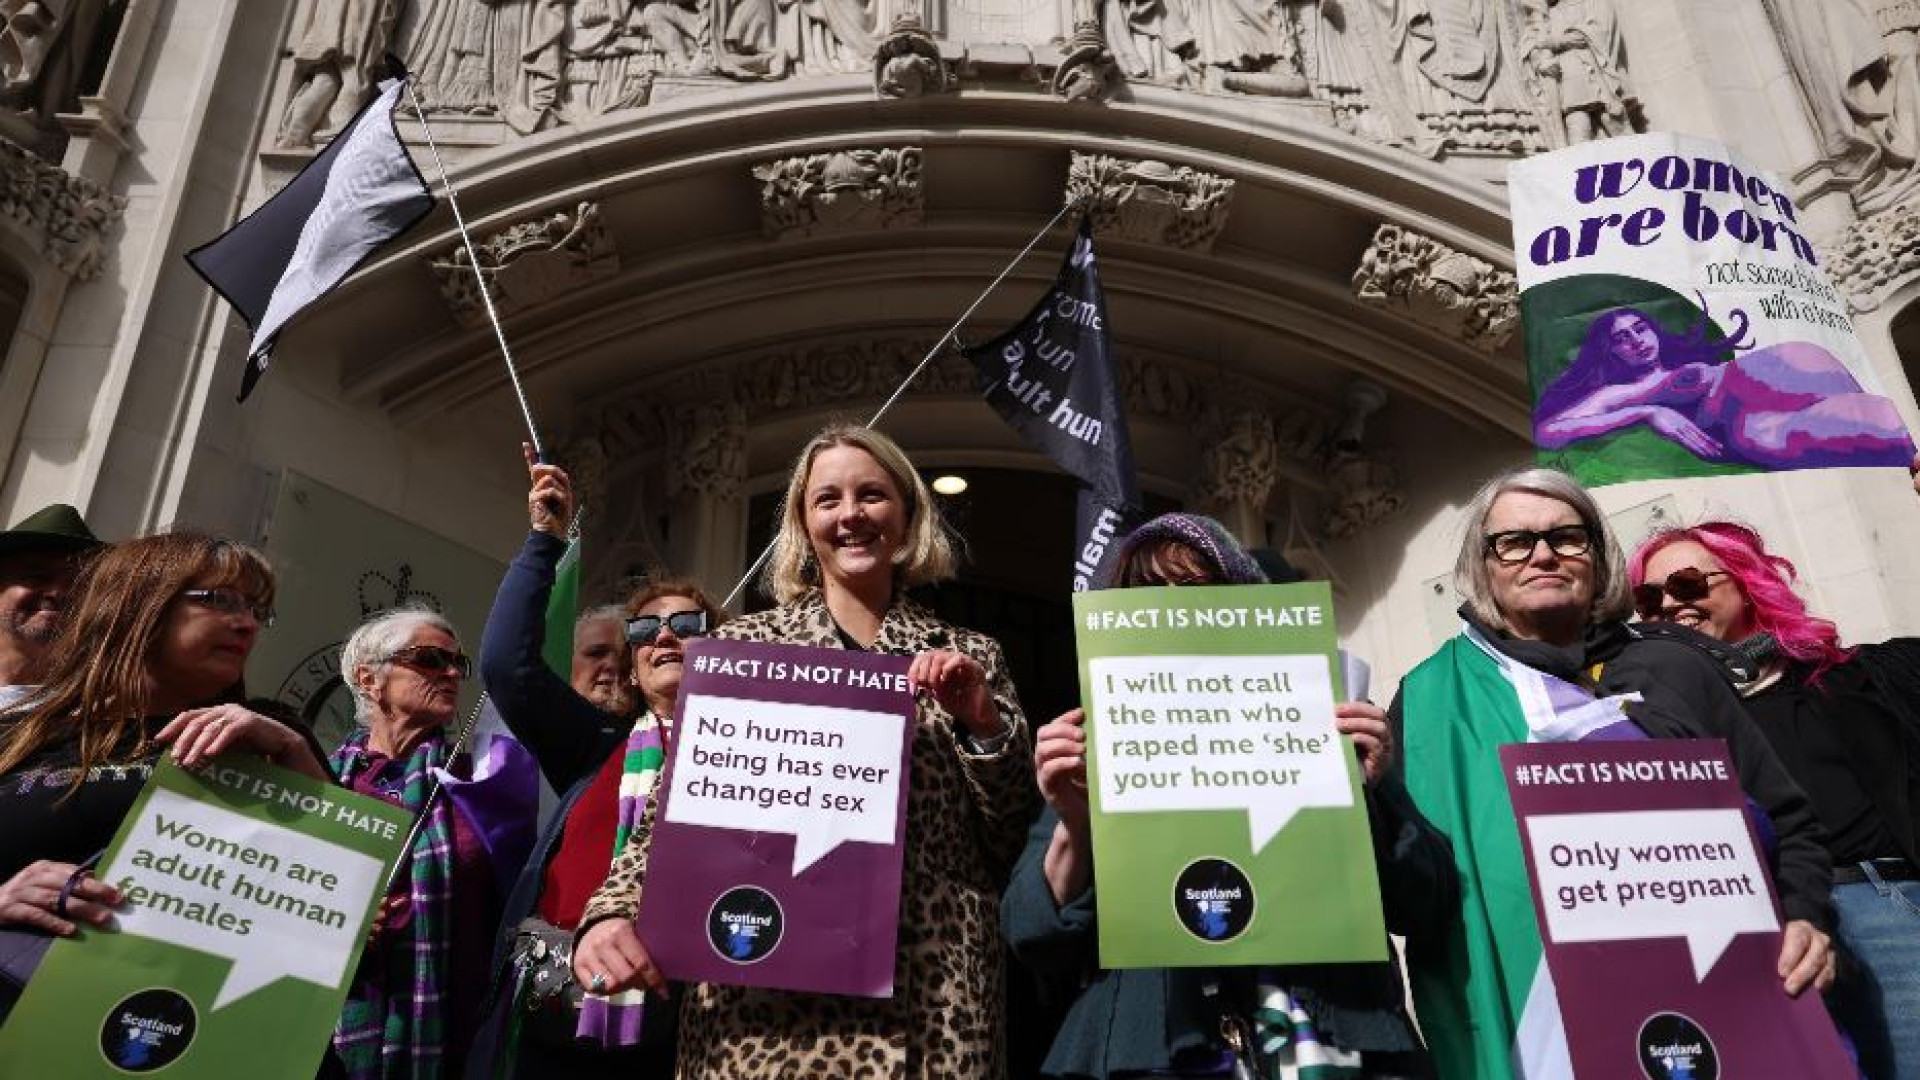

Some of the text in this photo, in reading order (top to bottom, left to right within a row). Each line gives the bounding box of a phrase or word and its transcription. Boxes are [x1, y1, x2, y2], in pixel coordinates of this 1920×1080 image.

[1574, 156, 1797, 224] women
[1530, 190, 1818, 266] are born
[1706, 259, 1743, 285] not
[1759, 290, 1799, 319] with
[1085, 606, 1323, 631] #FACT IS NOT HATE
[692, 655, 909, 693] #FACT IS NOT HATE
[1106, 672, 1292, 694] I will not call
[1107, 703, 1301, 725] the man who
[697, 715, 844, 748] No human
[1112, 733, 1199, 761] raped
[1209, 738, 1254, 755] me
[693, 744, 889, 785] being has ever
[1515, 760, 1729, 786] #FACT IS NOT HATE
[1114, 766, 1301, 794] your honour
[200, 762, 399, 841] ACT IS NOT HATE
[686, 777, 865, 813] changed sex
[154, 813, 339, 892] Women are
[1550, 841, 1736, 870] Only women
[131, 847, 346, 930] adult human
[1184, 886, 1241, 899] Scotland
[1558, 873, 1755, 910] get pregnant
[116, 876, 253, 936] females
[720, 910, 772, 927] Scotland
[121, 1012, 184, 1035] Scotland
[1648, 1042, 1702, 1057] Scotland
